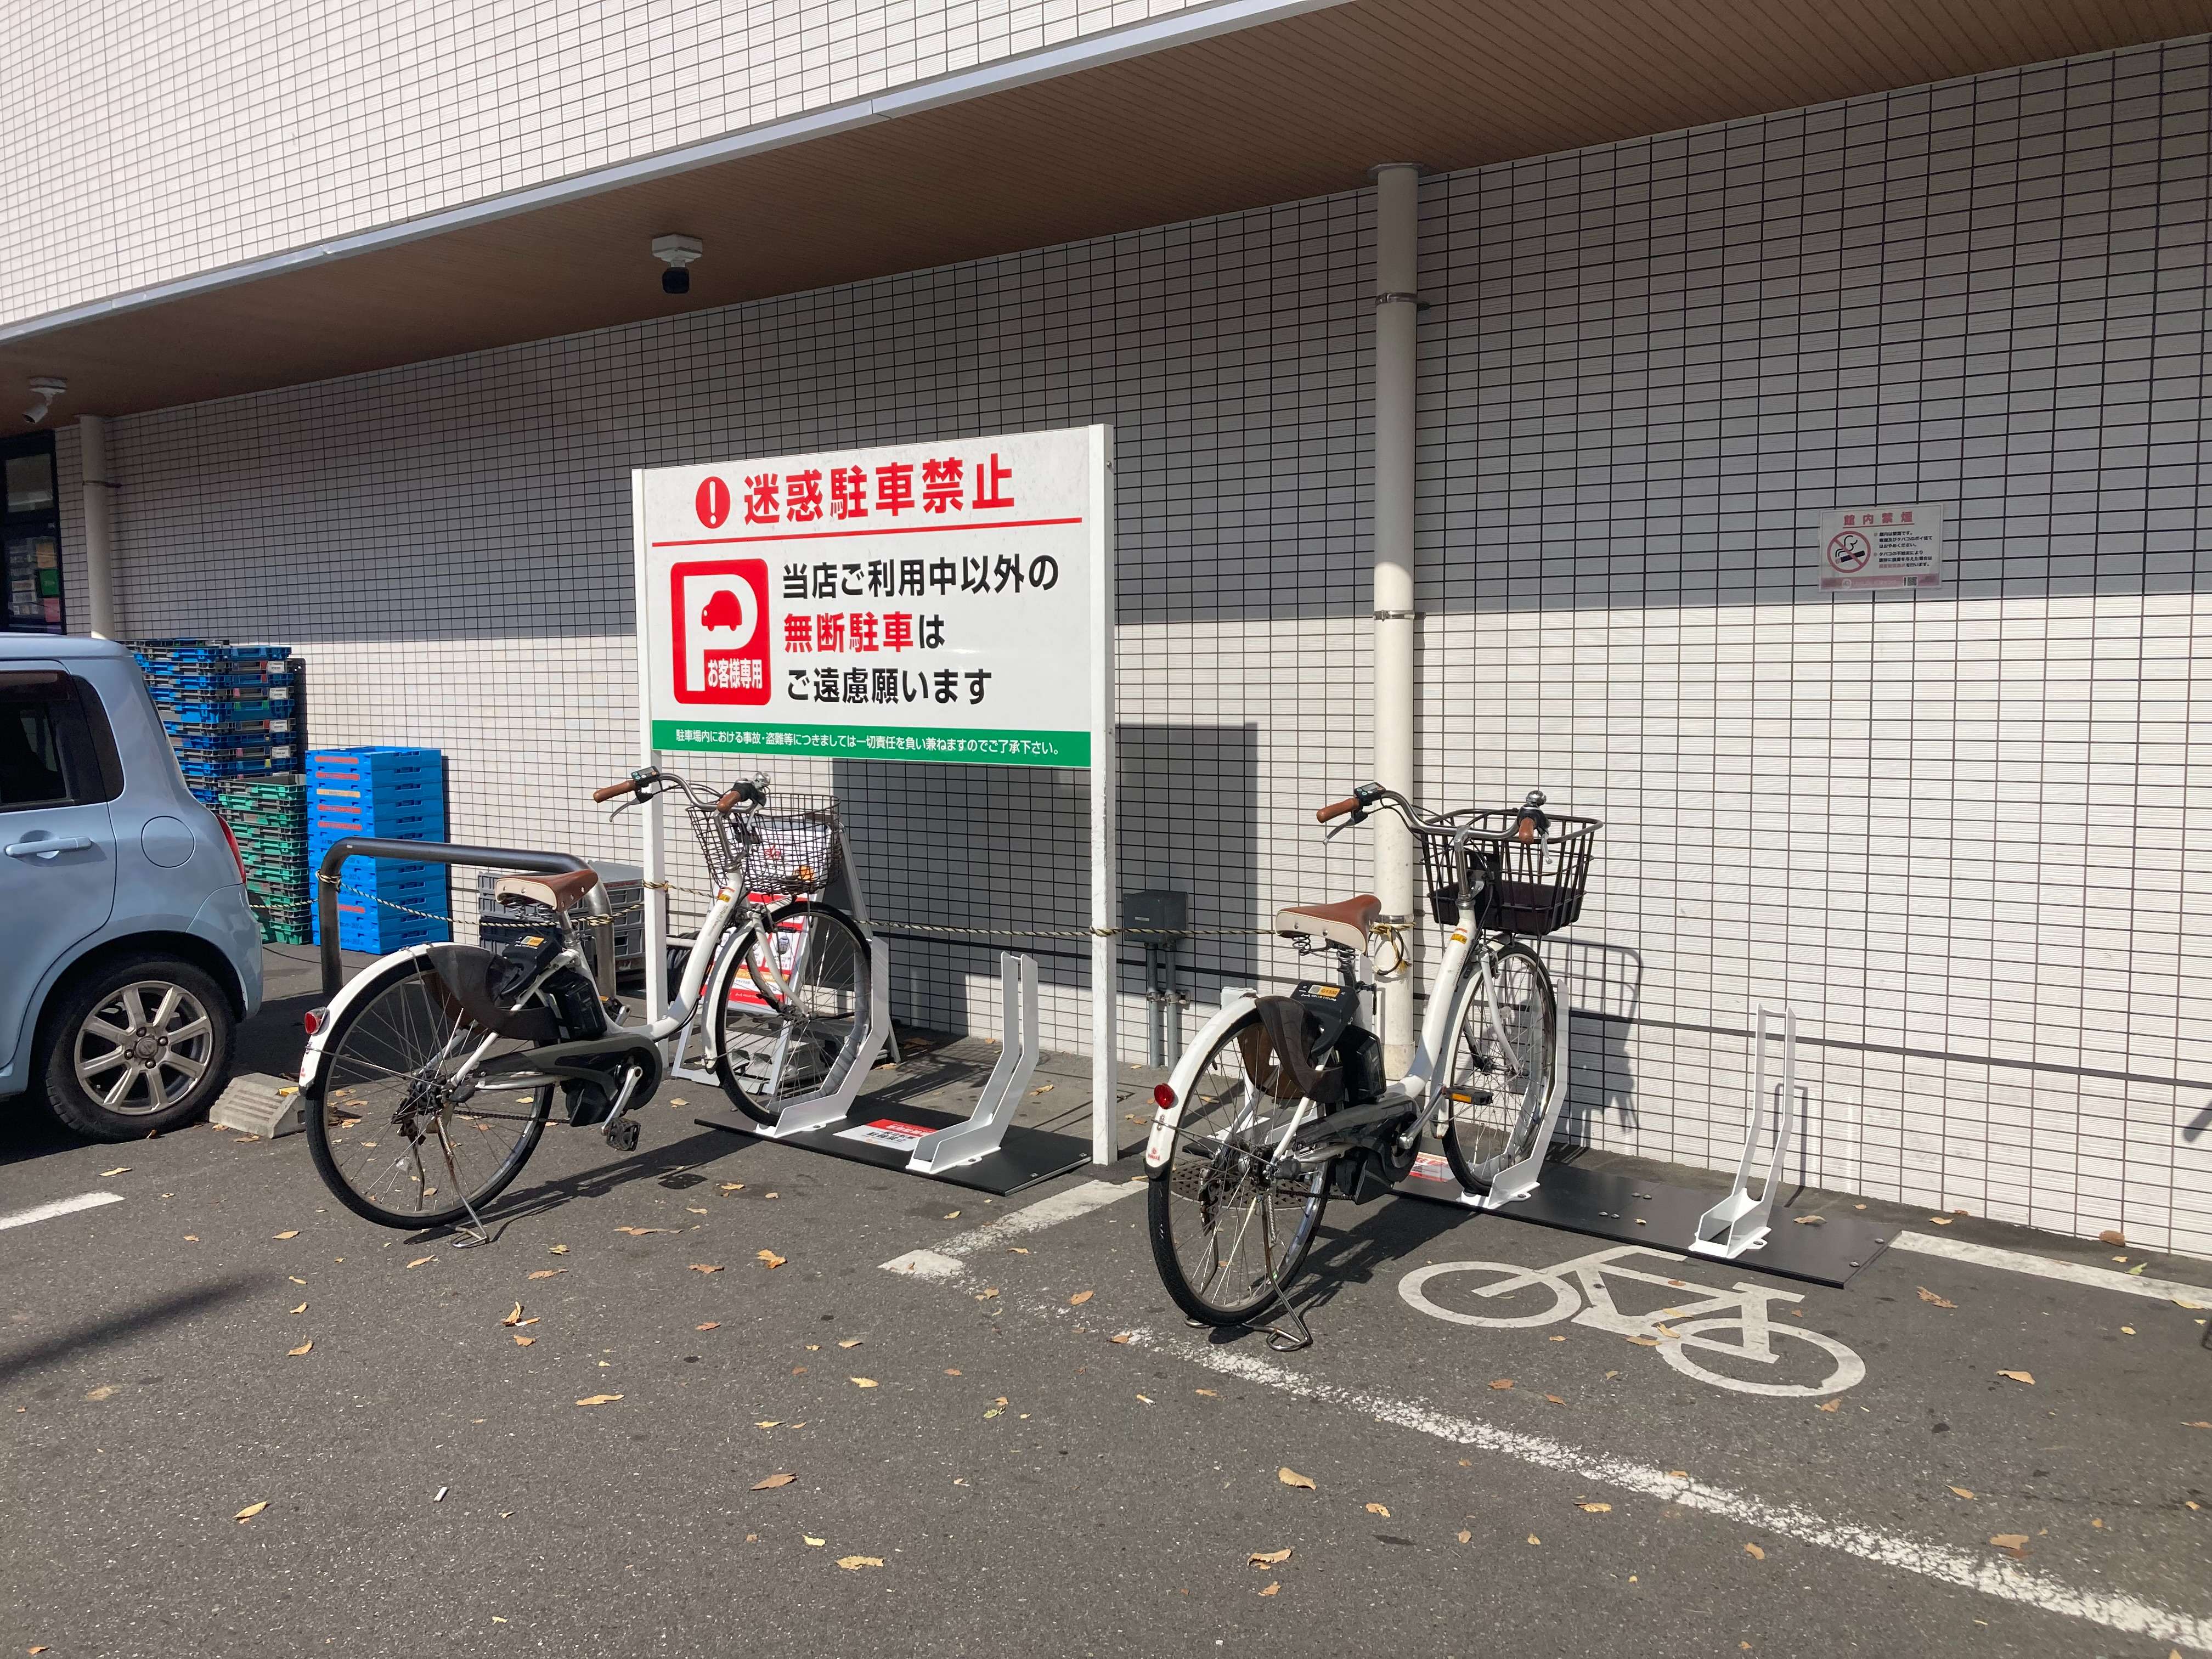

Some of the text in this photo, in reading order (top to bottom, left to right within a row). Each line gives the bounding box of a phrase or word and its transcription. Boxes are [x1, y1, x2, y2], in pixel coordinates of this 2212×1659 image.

[744, 453, 1014, 525] 迷惑駐車禁止
[783, 553, 1059, 599] 当店ご利用中以外の
[784, 611, 946, 653] 無断駐車は
[708, 658, 763, 689] お客様専用
[788, 667, 992, 705] ご遠慮願います
[675, 729, 1058, 755] 駐車場内における事故・盗難等につきましては一切責任を負い兼ねますのでご了承下さい。
